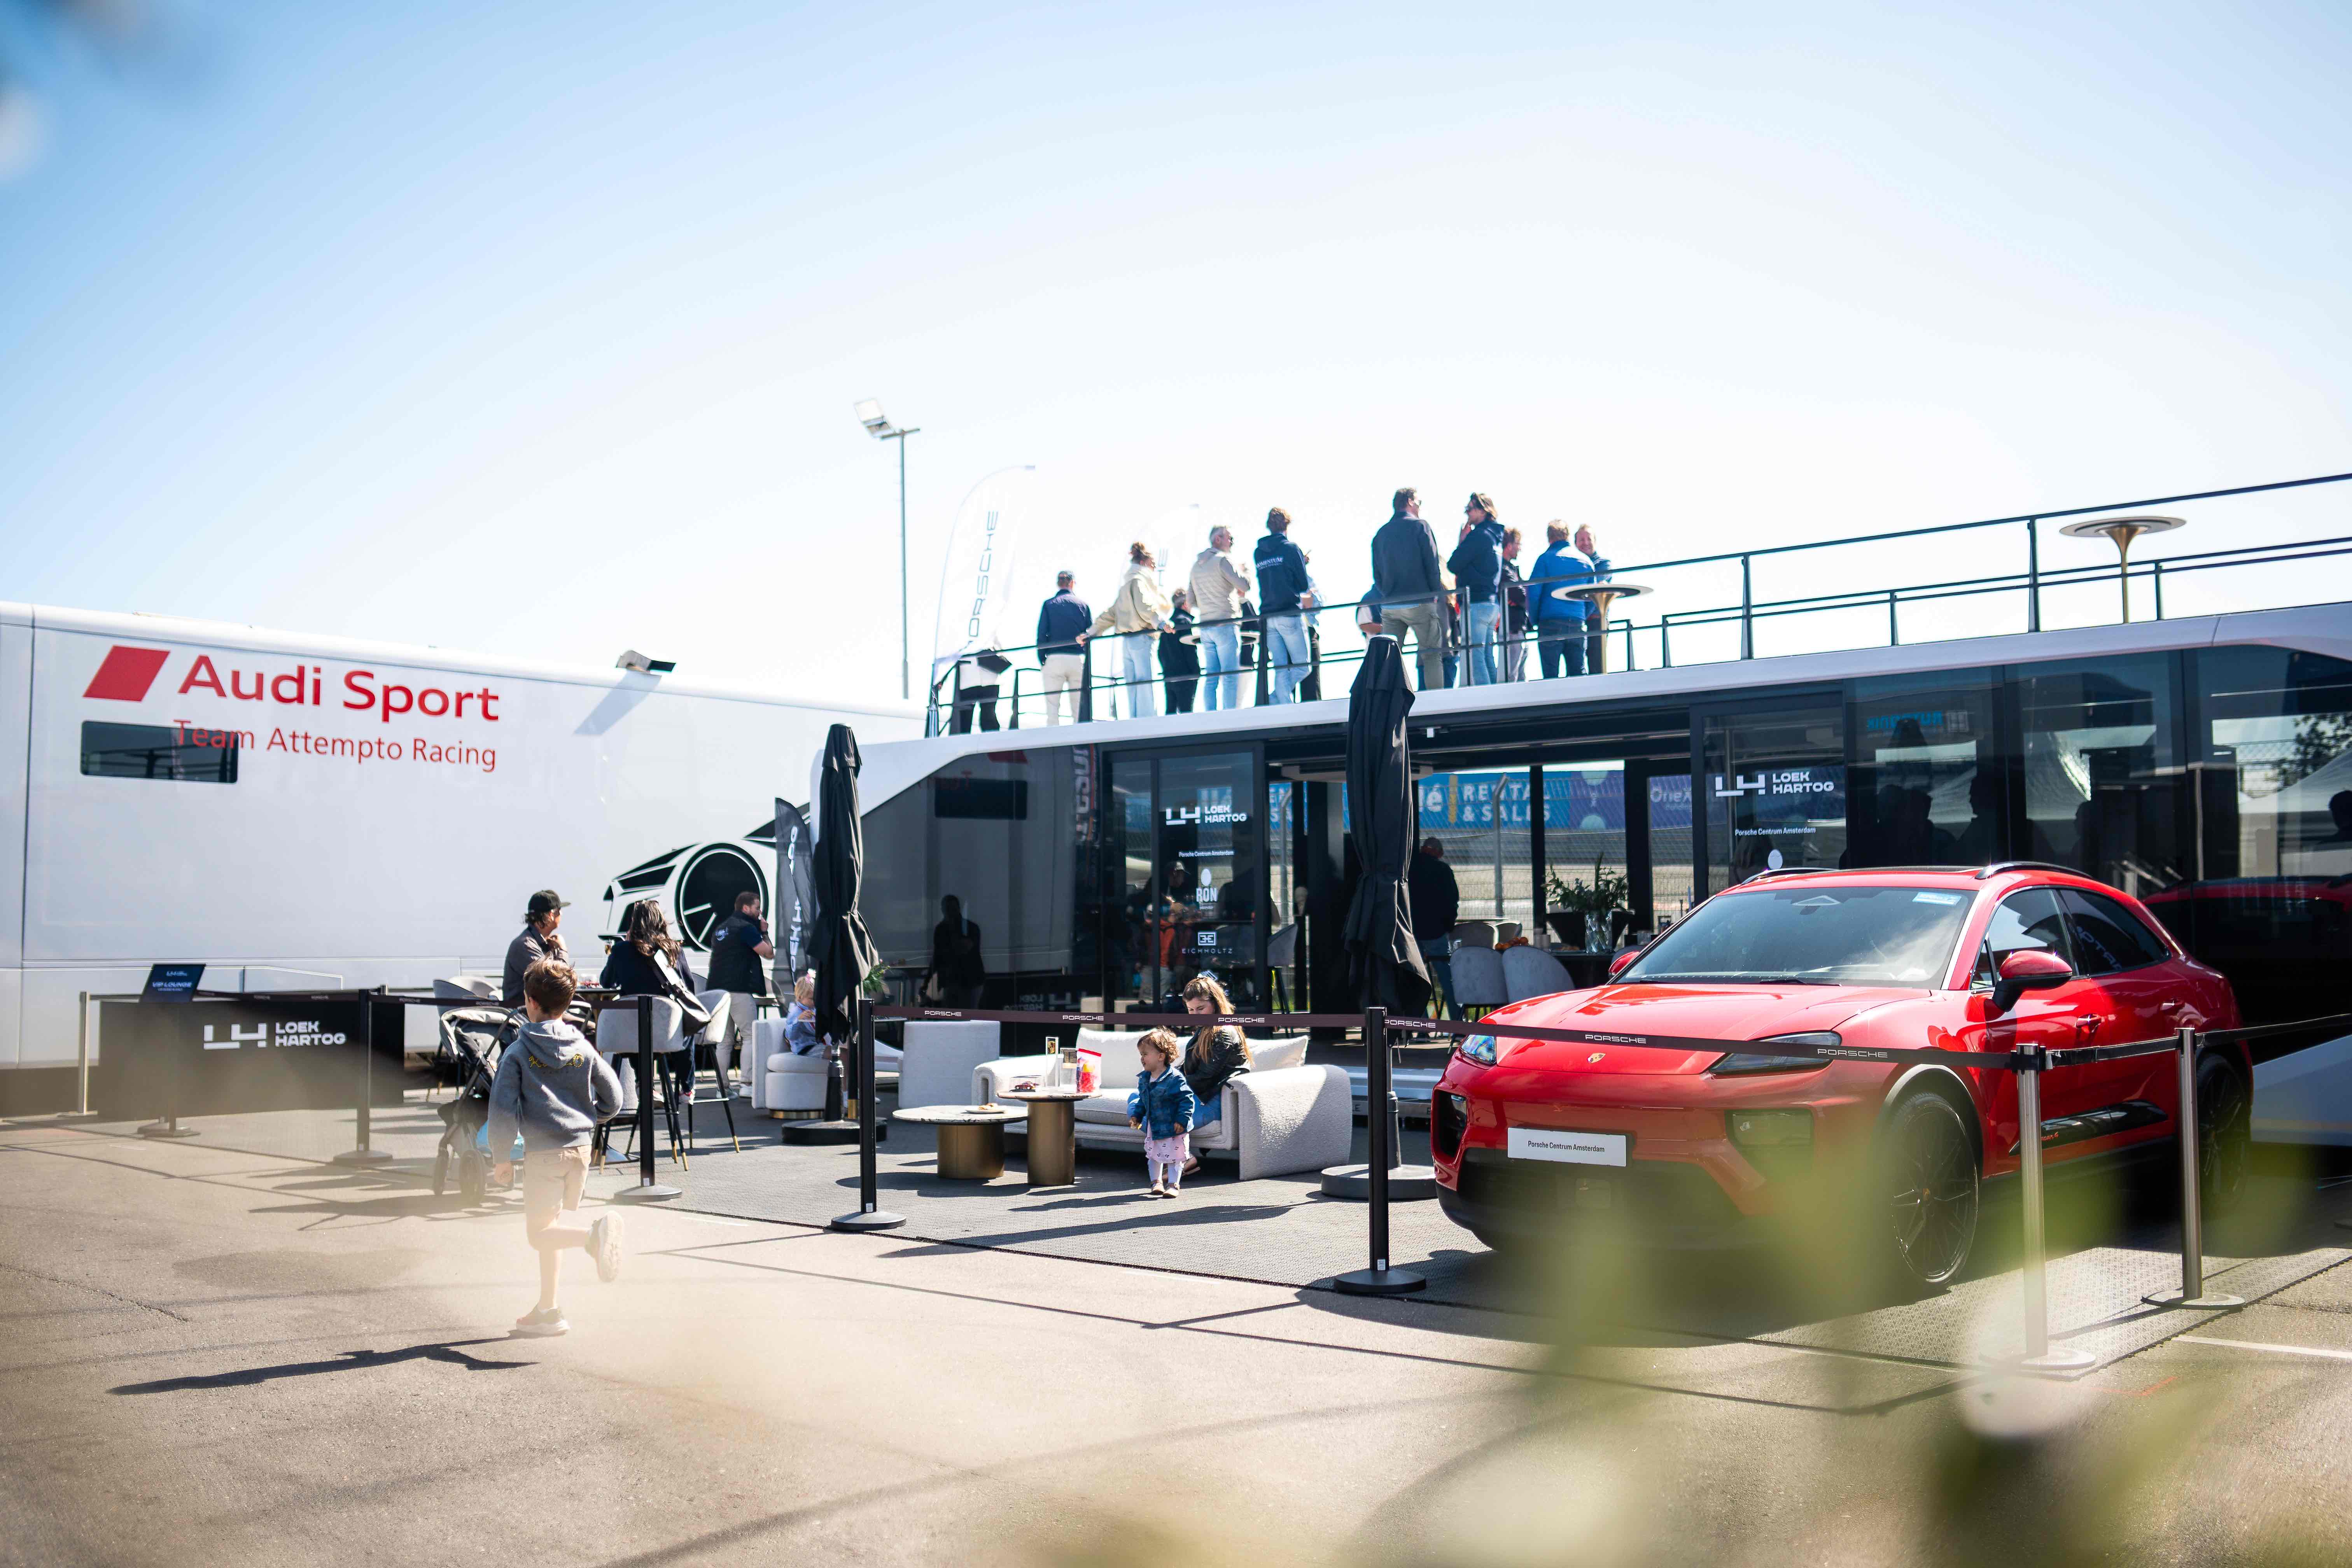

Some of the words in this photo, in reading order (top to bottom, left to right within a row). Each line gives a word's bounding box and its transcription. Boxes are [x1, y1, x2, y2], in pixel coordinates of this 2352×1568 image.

[968, 511, 998, 644] ORSCHE
[177, 654, 321, 706] Audi
[343, 670, 499, 723] Sport
[173, 719, 254, 749] Team
[267, 728, 402, 764] Attempto
[413, 738, 495, 772] Racing
[1772, 771, 1810, 783] LOEK
[1463, 783, 1550, 801] RETA
[1773, 781, 1835, 794] HARTOG
[1204, 805, 1230, 814] LOEK
[1463, 806, 1475, 822] &
[1205, 814, 1248, 823] HARTOG
[1196, 887, 1217, 902] RON
[275, 1021, 320, 1034] LOEK
[1384, 1019, 1436, 1029] PORSCHE
[275, 1032, 346, 1047] HARTOG
[1585, 1034, 1647, 1044] PORSCHE
[1817, 1049, 1888, 1058] PORSCHE
[1528, 1140, 1548, 1149] Porsche
[1549, 1142, 1572, 1151] Centrum
[1573, 1143, 1605, 1153] Amsterdam
